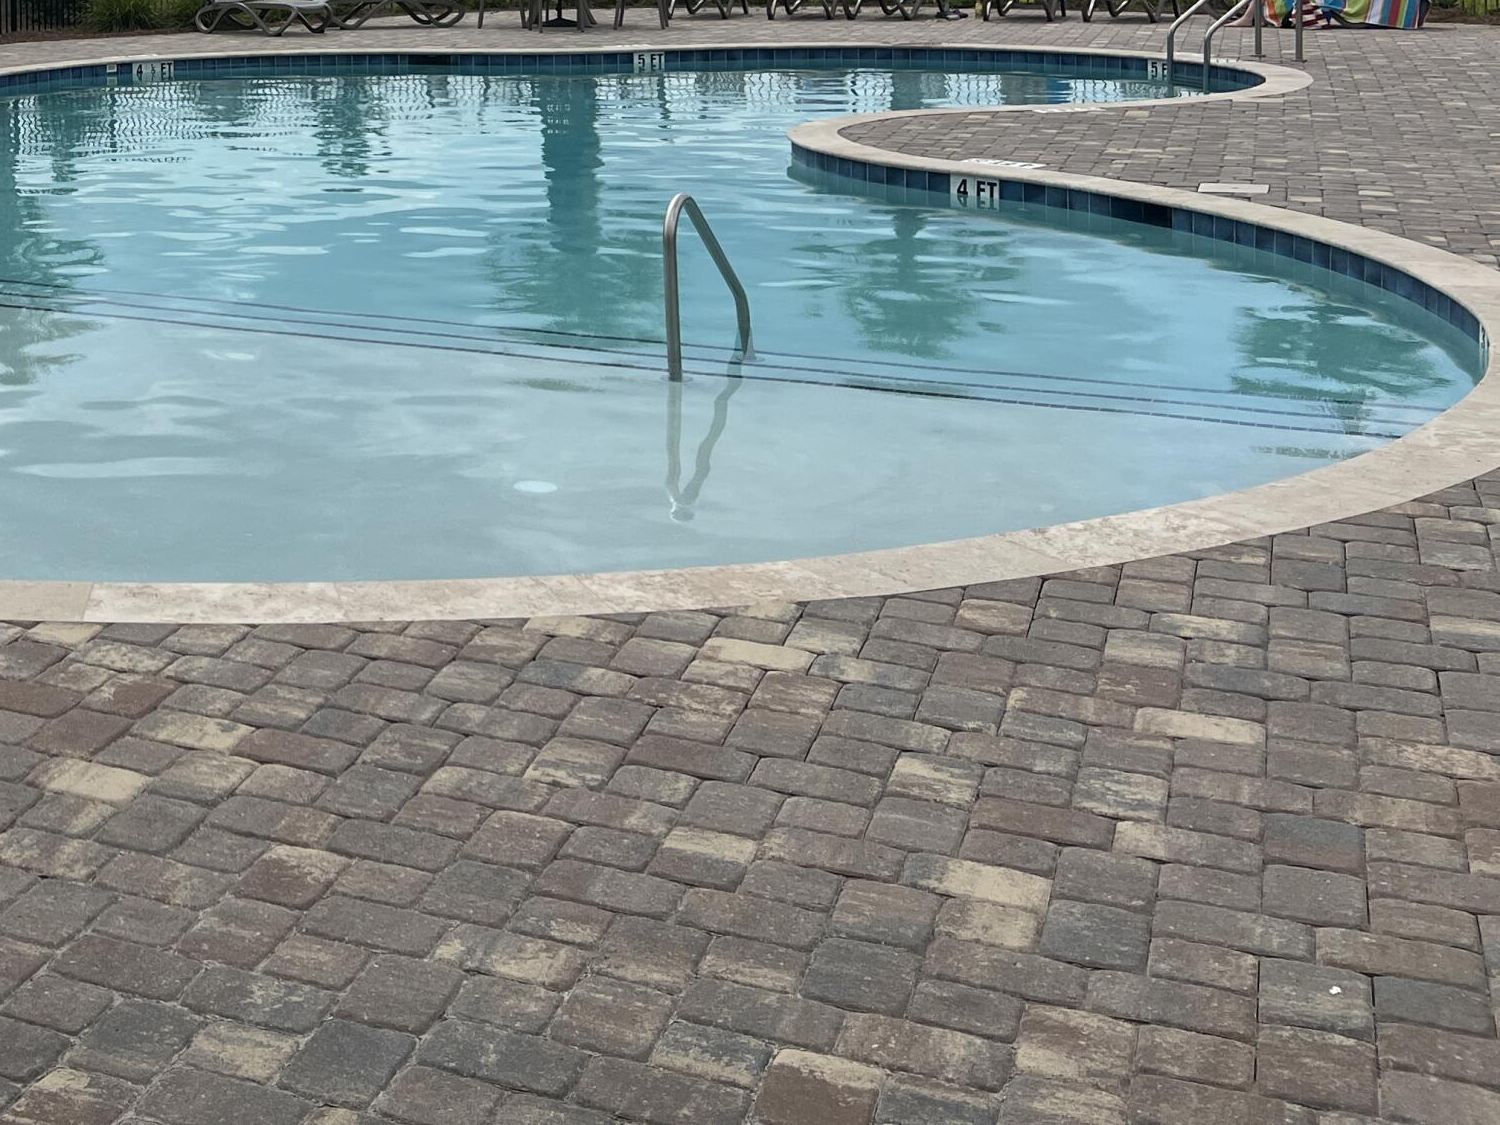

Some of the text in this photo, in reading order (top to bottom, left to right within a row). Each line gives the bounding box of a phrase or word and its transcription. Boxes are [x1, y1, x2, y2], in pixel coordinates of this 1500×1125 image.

[638, 53, 663, 65] 5 FT
[137, 64, 143, 73] 4
[161, 63, 172, 73] FT
[1151, 61, 1158, 73] 5
[957, 178, 998, 198] 4 FT
